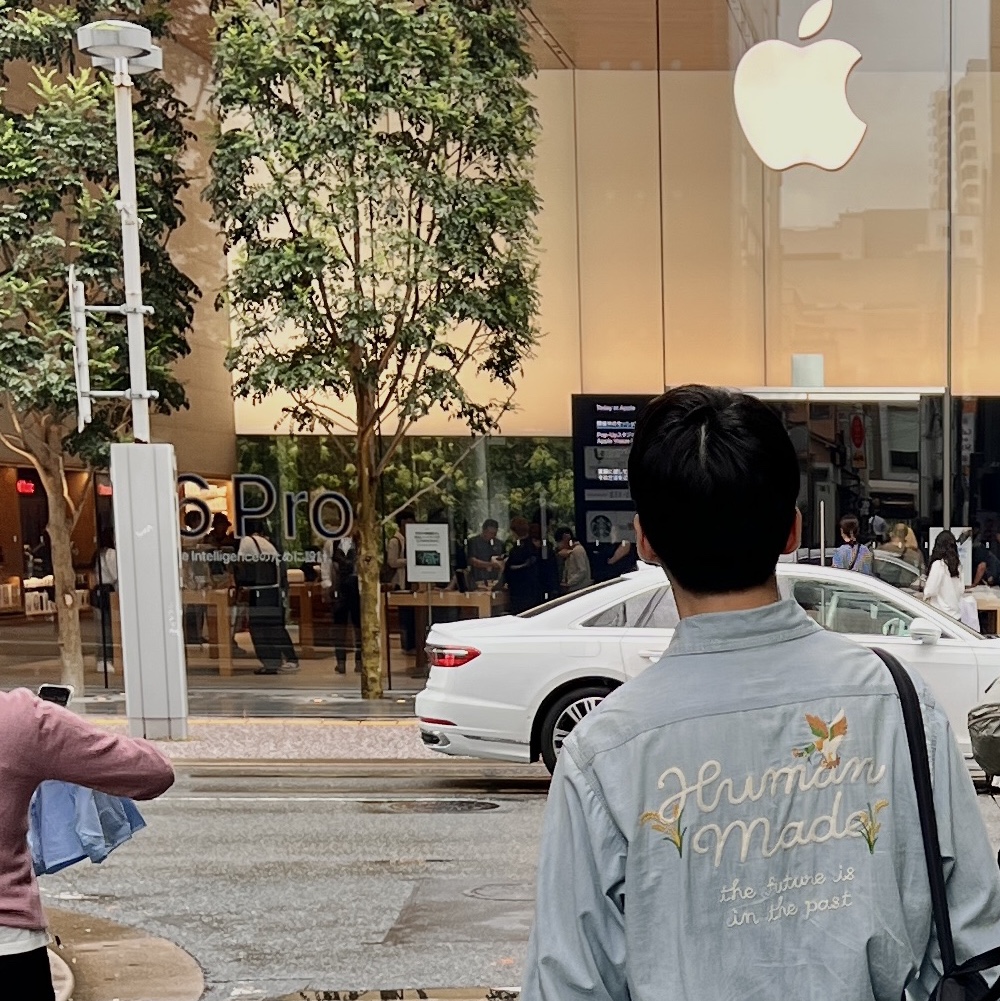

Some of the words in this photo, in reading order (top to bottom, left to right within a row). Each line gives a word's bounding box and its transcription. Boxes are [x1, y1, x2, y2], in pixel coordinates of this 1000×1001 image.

[177, 473, 212, 540] 6
[231, 473, 355, 541] Pro
[657, 756, 886, 824] Human
[719, 878, 756, 903] the
[765, 871, 825, 897] future
[832, 864, 855, 883] is
[726, 908, 760, 928] in
[767, 896, 798, 922] the
[804, 891, 853, 919] past
